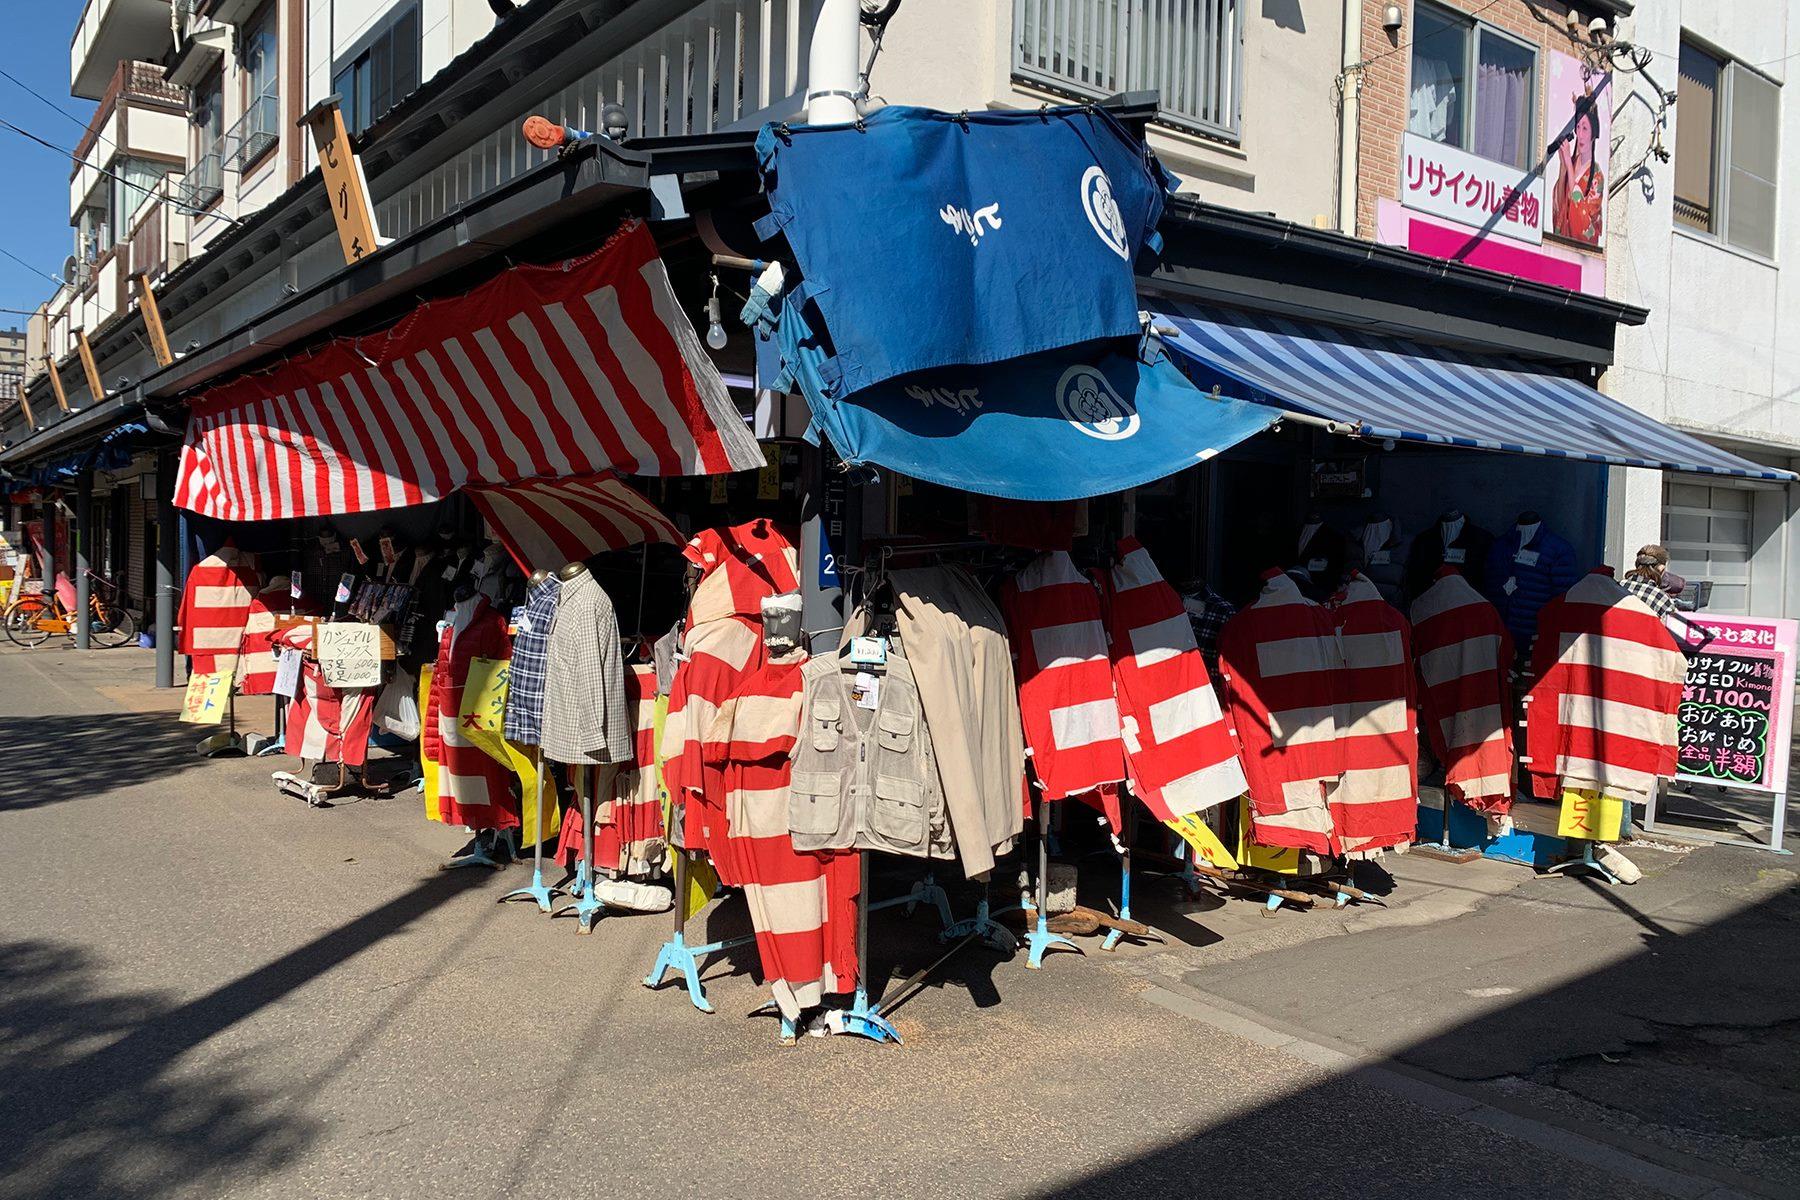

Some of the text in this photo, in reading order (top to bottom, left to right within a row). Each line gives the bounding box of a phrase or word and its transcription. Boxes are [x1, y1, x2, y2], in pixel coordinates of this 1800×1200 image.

[1408, 154, 1540, 229] リサイクル着物
[1685, 672, 1734, 688] USED
[1682, 705, 1766, 735] おびあげ
[1682, 726, 1756, 754] おびじめ
